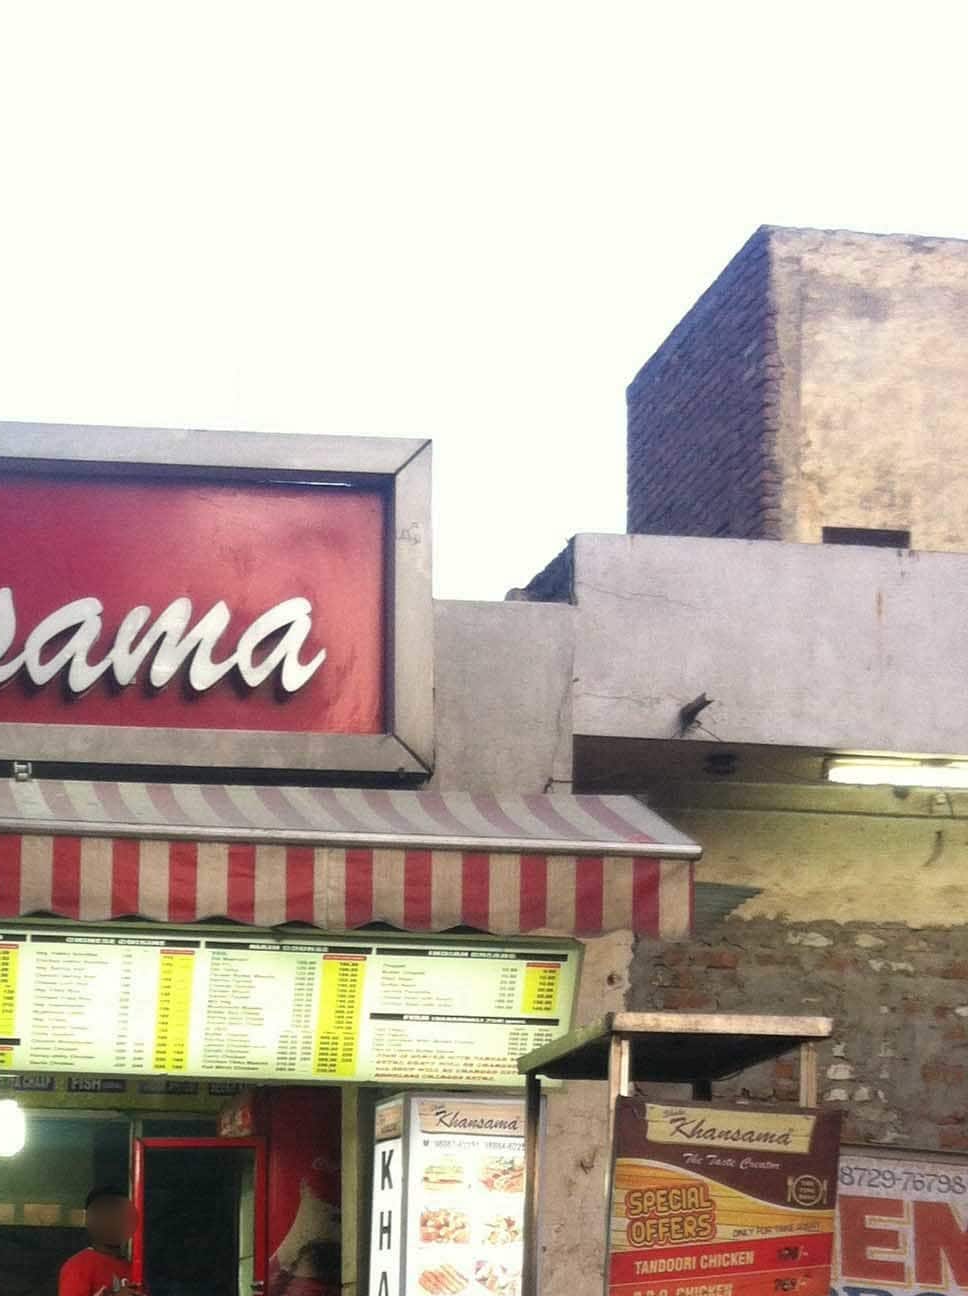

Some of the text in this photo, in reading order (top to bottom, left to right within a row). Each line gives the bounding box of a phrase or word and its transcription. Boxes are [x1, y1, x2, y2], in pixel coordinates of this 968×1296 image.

[71, 1077, 102, 1092] FISH
[435, 1108, 520, 1131] Khansama
[669, 1115, 793, 1146] Khansama
[682, 1152, 780, 1170] The Taste Creator
[626, 1186, 712, 1217] SPECIAL
[629, 1216, 713, 1245] OFFERS
[634, 1260, 697, 1276] TANDOORI
[699, 1250, 755, 1270] CHICKEN
